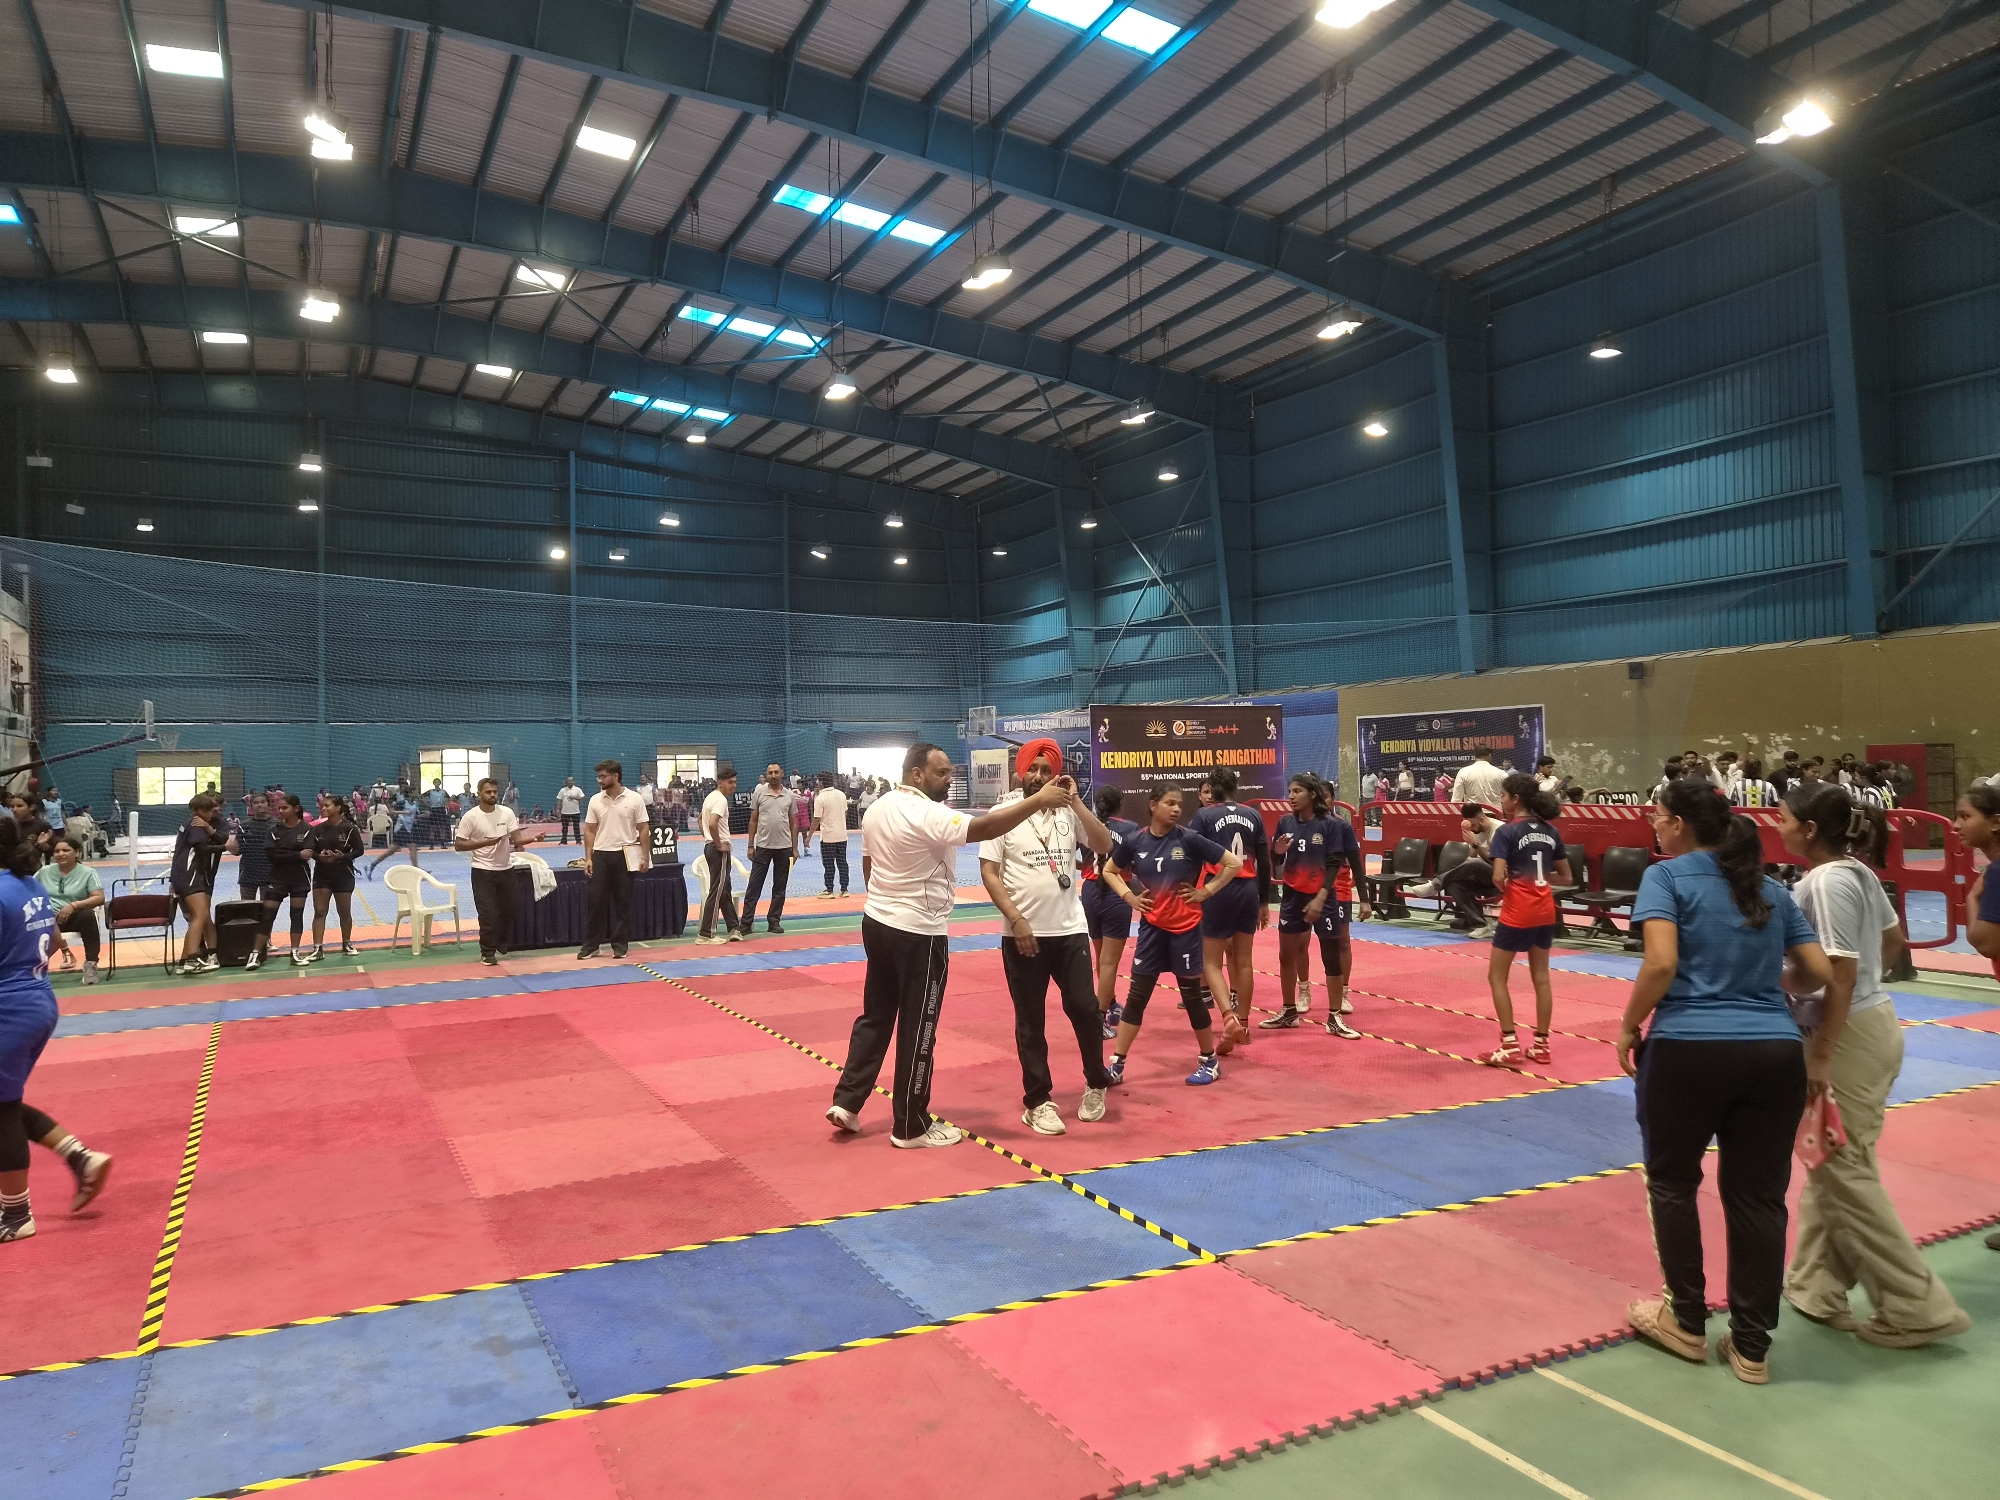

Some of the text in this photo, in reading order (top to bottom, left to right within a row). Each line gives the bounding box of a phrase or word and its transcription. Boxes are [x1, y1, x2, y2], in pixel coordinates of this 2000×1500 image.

[1381, 740, 1416, 754] KENDRIYA
[1419, 738, 1460, 752] VIDYALAYA
[1100, 748, 1276, 769] KENDRIYA VIDYALAYA SANGATHAN
[654, 828, 674, 845] 32
[652, 846, 675, 855] GUEST
[1231, 832, 1247, 866] 4
[1298, 839, 1306, 852] 3
[1155, 857, 1164, 872] 7
[1531, 851, 1547, 887] 1
[1338, 906, 1344, 918] 6
[1326, 918, 1333, 931] 3
[921, 1022, 932, 1055] ESSENTIALS
[915, 1062, 925, 1094] ESSENTIALS
